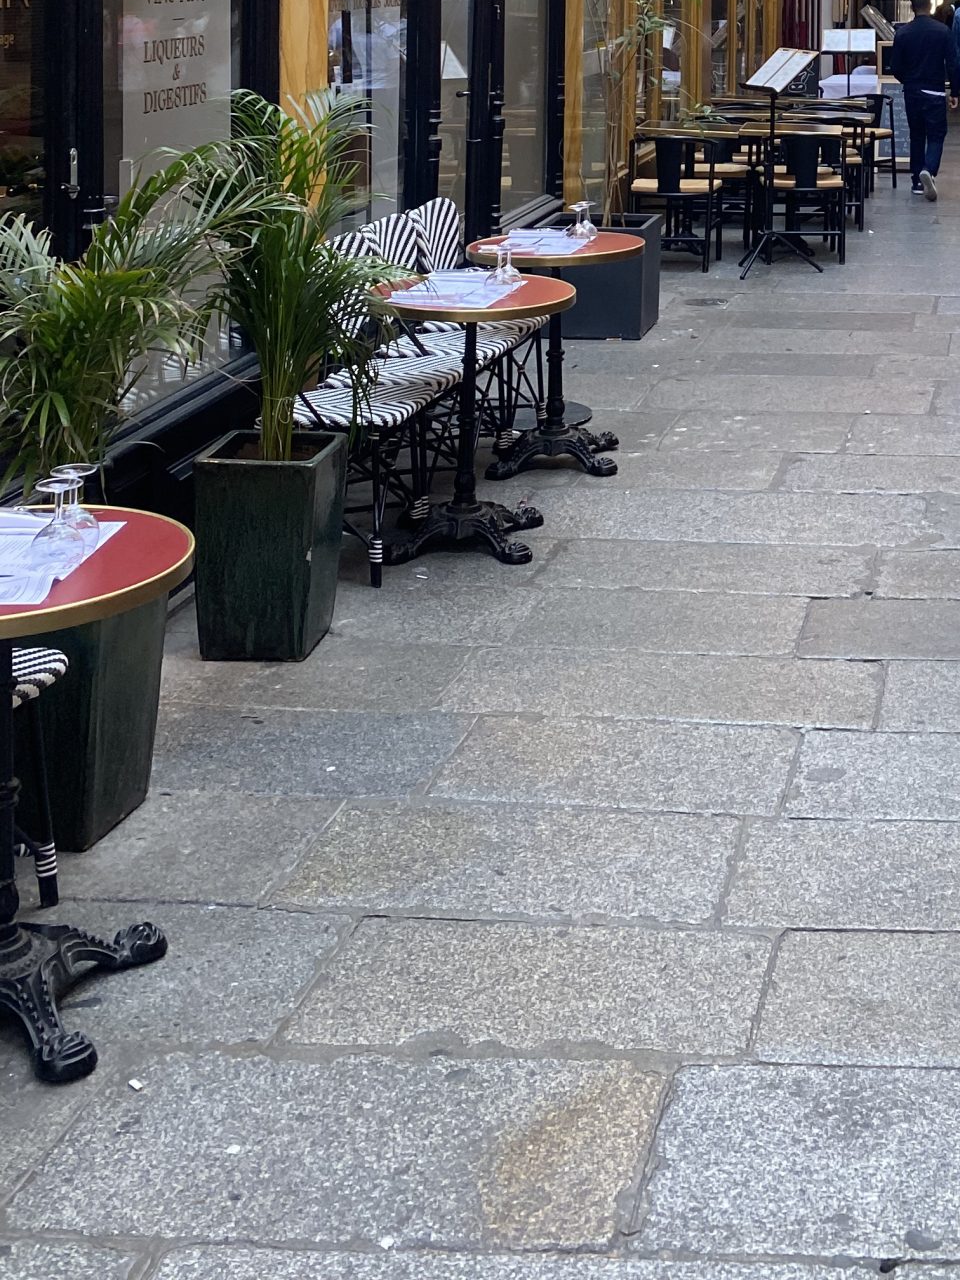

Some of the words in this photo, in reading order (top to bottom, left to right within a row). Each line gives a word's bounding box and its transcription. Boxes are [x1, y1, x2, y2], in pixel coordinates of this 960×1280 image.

[144, 35, 205, 65] LIQUEURS
[172, 64, 181, 80] &
[143, 81, 207, 114] DIGESTIFS
